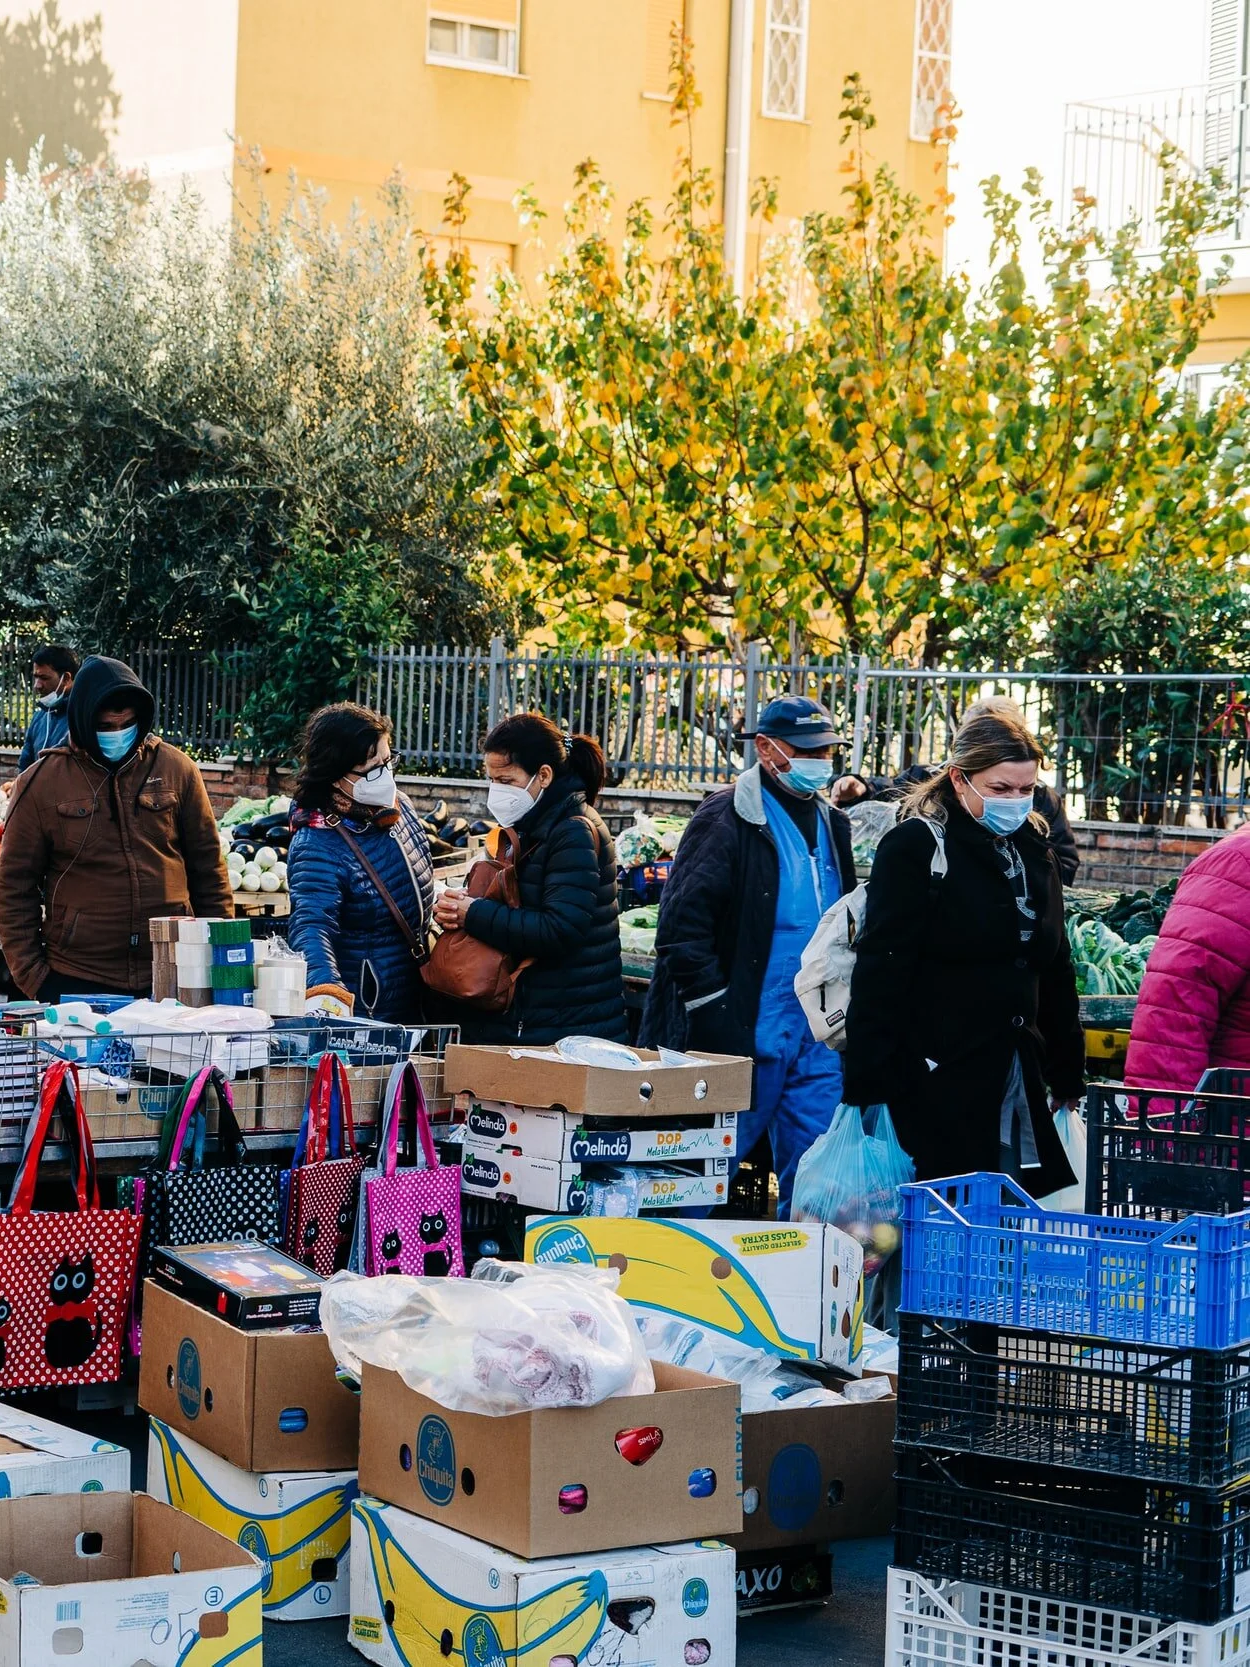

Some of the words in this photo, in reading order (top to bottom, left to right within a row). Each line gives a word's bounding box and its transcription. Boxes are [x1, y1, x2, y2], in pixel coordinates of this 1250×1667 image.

[328, 1036, 364, 1052] CANDLE
[365, 1042, 398, 1056] DECOR
[470, 1114, 505, 1132] Melinda
[573, 1136, 628, 1157] Melinda
[646, 1147, 661, 1156] Mela
[678, 1145, 690, 1153] Non
[463, 1164, 498, 1181] Melinda
[741, 1234, 769, 1243] EXTRA
[770, 1231, 798, 1240] CLASS
[742, 1243, 771, 1252] QUALITY
[771, 1240, 801, 1250] SELECTED
[418, 1458, 454, 1489] Chiquita
[735, 1564, 782, 1597] AXO
